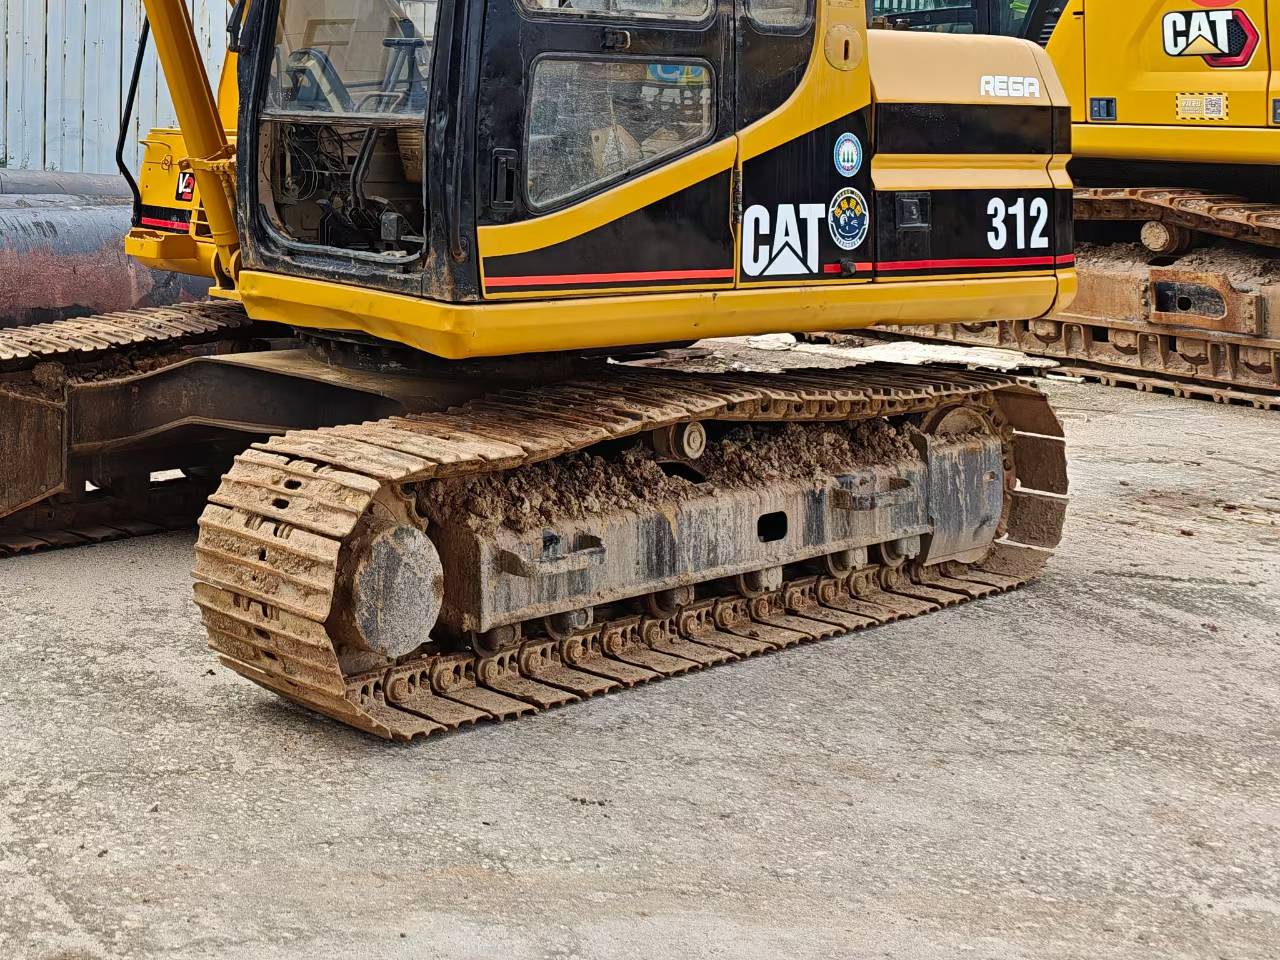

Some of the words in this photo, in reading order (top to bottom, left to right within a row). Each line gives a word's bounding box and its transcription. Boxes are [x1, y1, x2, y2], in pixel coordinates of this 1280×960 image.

[1163, 10, 1233, 56] CAT
[980, 75, 1040, 98] REGA
[742, 203, 826, 277] CAT
[986, 197, 1049, 250] 312
